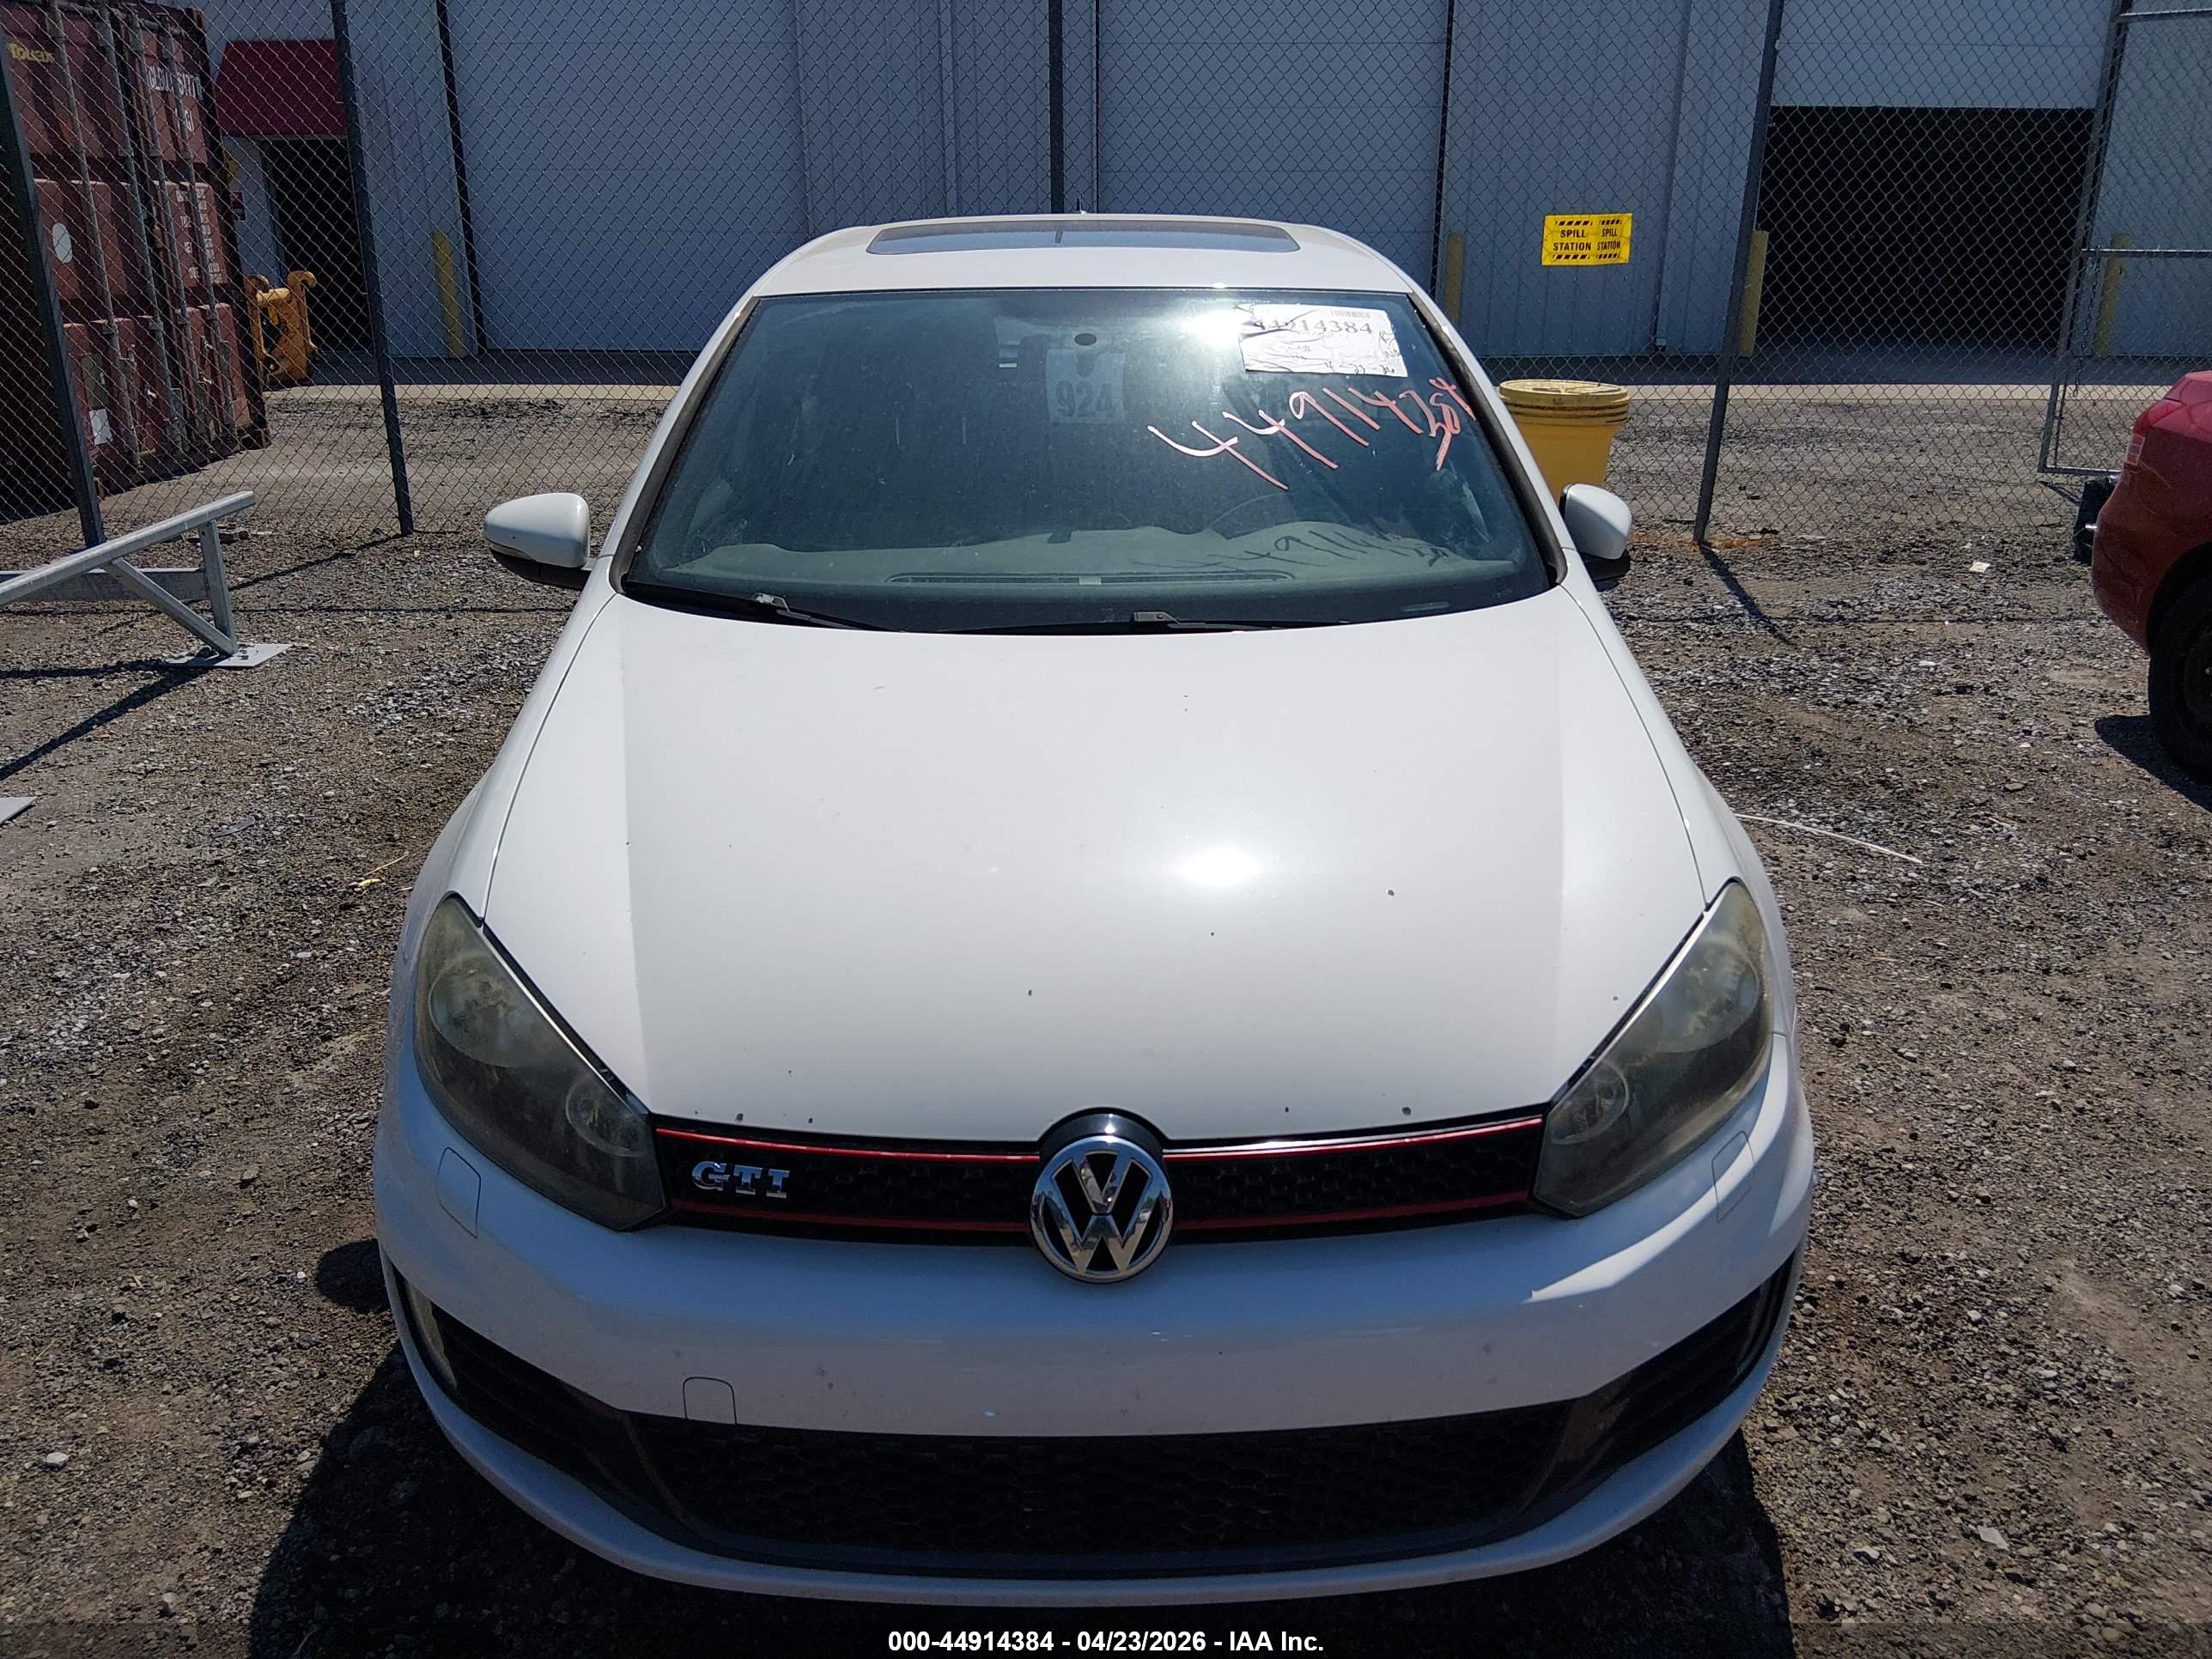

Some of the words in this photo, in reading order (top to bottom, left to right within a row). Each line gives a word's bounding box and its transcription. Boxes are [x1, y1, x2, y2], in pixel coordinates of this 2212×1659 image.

[1560, 228, 1586, 238] SPILL
[1601, 228, 1618, 237] SPILL
[1553, 241, 1592, 252] STATION
[1596, 240, 1621, 251] STATION
[1055, 380, 1115, 418] 924
[691, 1160, 791, 1200] GTI
[1036, 1142, 1168, 1279] VW
